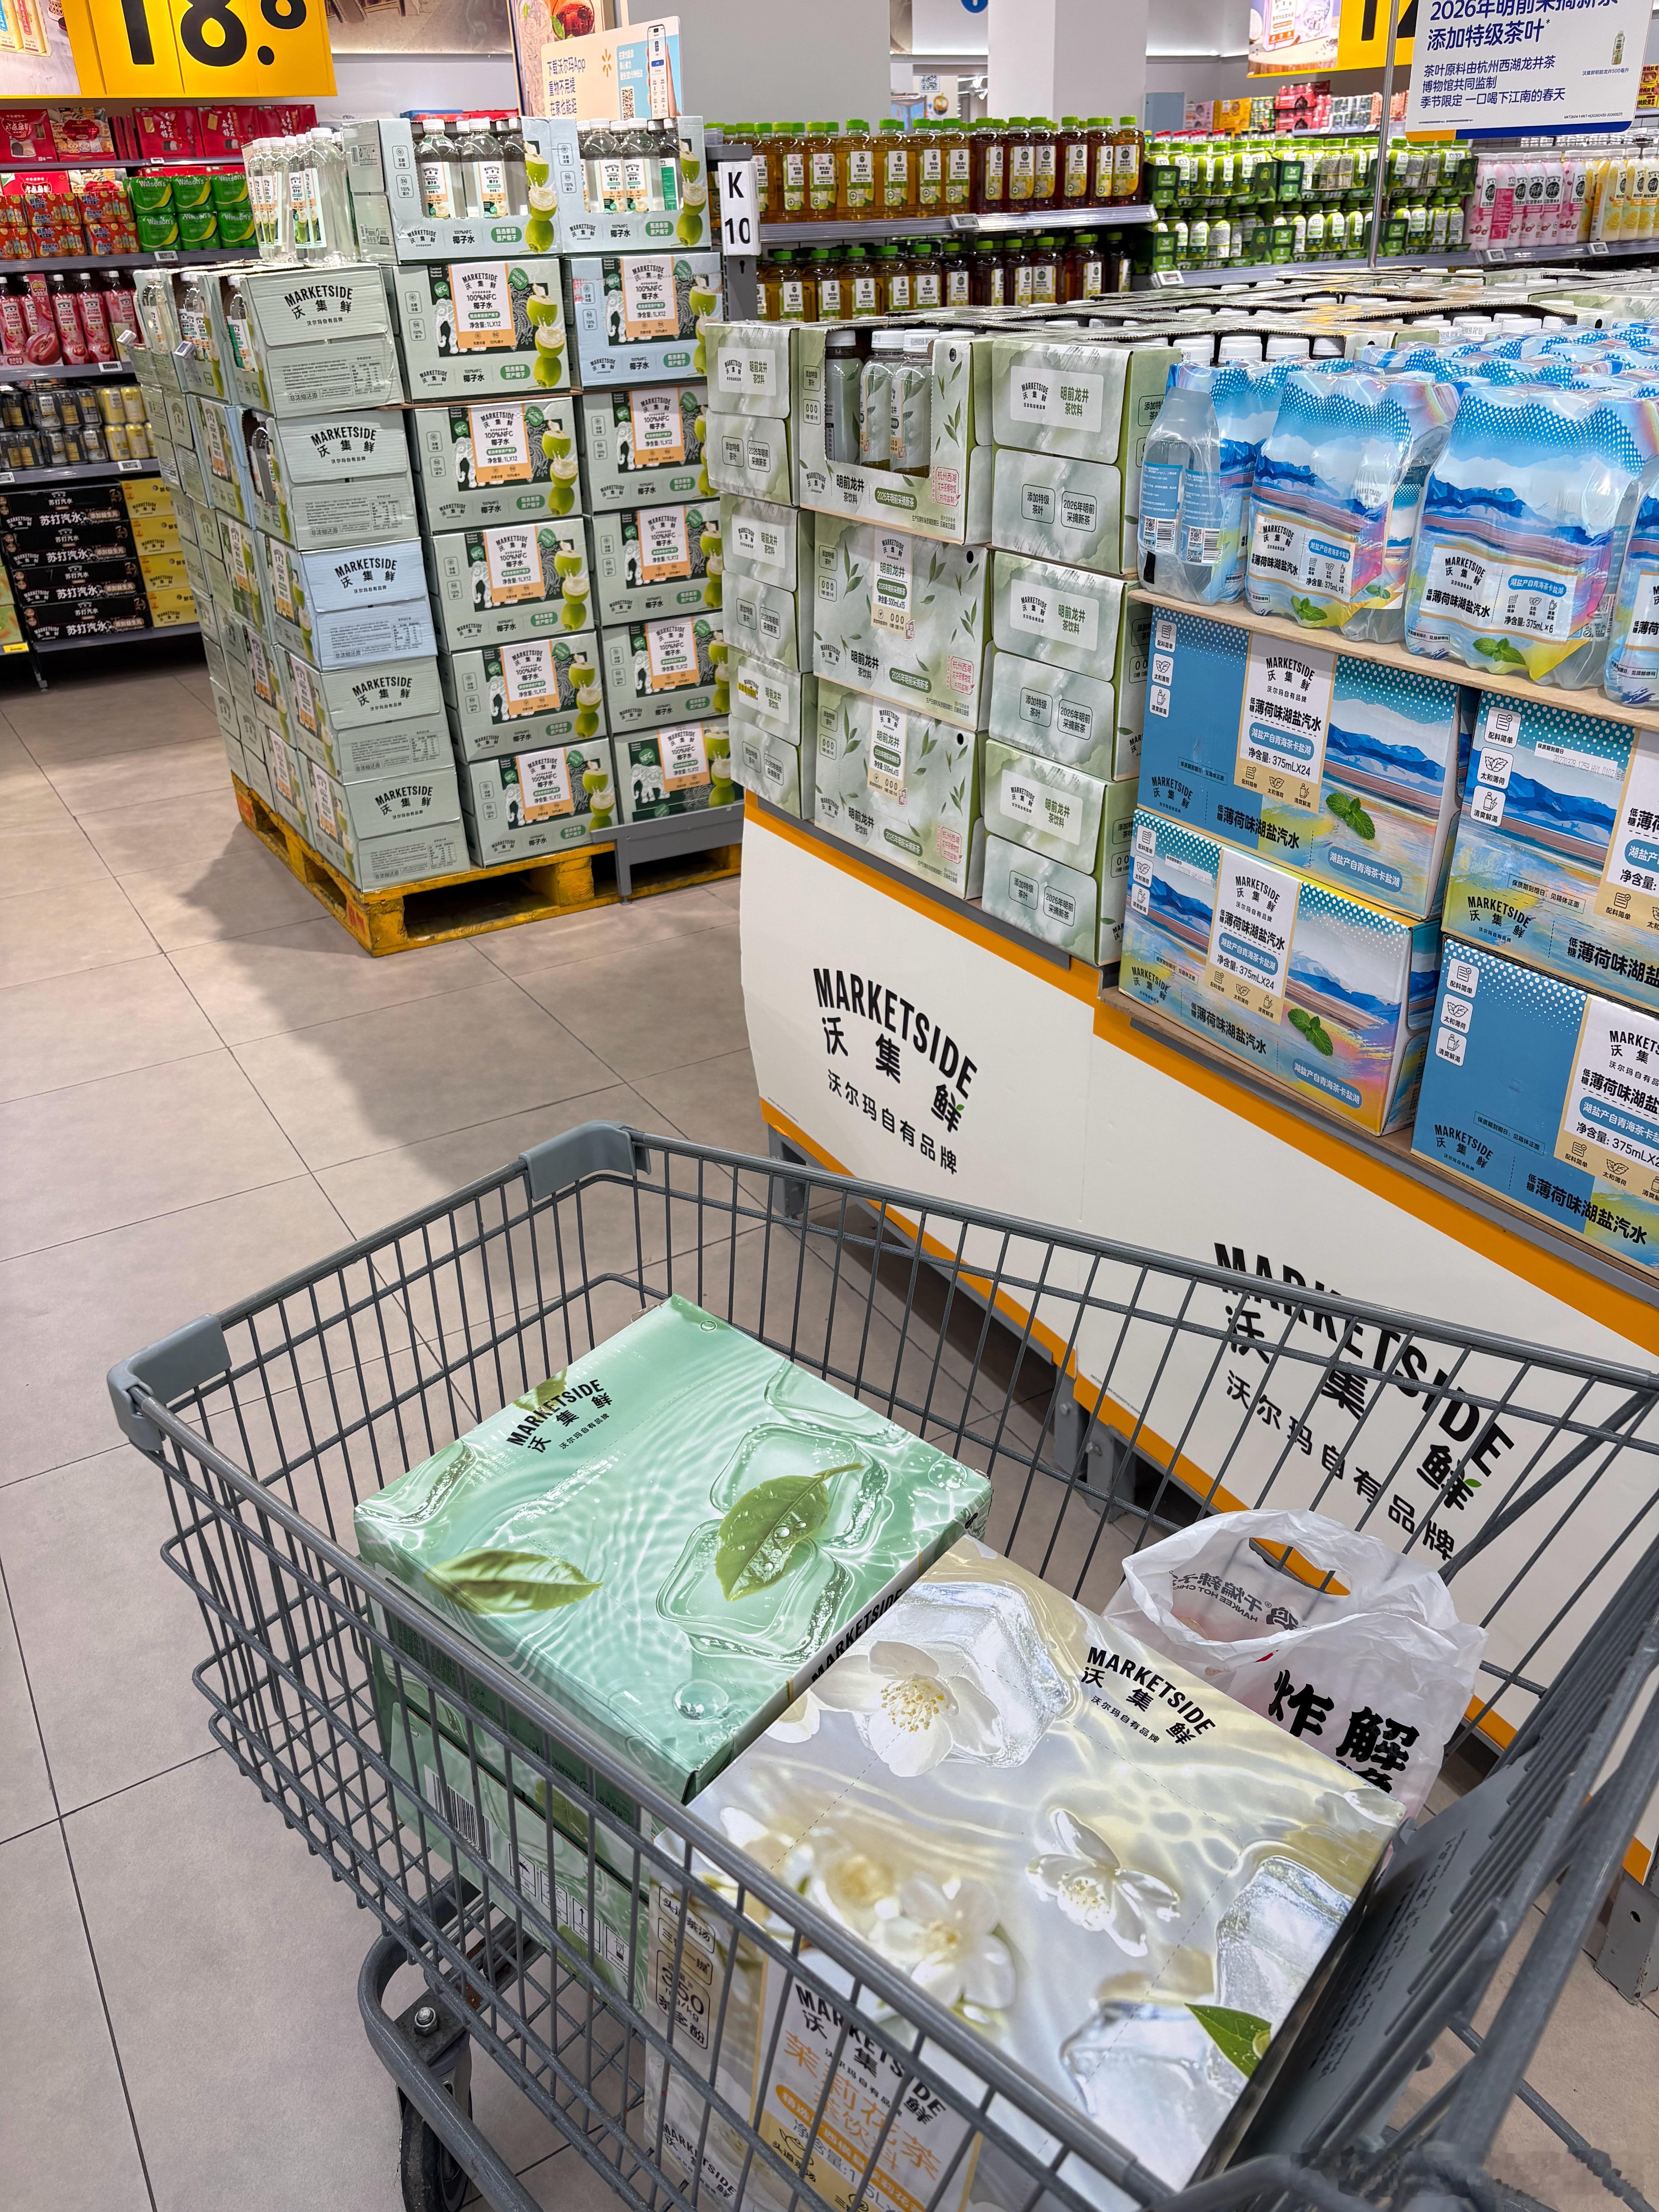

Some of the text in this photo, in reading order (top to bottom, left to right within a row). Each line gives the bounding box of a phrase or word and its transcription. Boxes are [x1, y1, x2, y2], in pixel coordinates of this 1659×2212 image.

[1424, 55, 1556, 77] 茶叶原料由杭州西湖龙井茶
[1422, 76, 1497, 93] 博物馆共同监制
[1420, 88, 1566, 109] 季节限定 一口喝下江南的春天
[728, 171, 744, 199] K
[453, 235, 475, 244] 椰子水
[725, 217, 750, 244] 10
[462, 273, 498, 287] MARKETSIDE
[284, 285, 353, 307] MARKETSIDE
[291, 299, 352, 320] 沃集鲜
[1021, 381, 1049, 395] MARKETSIDE
[1060, 386, 1089, 404] 明前龙井
[480, 411, 515, 421] MARKETSIDE
[1065, 402, 1083, 417] 茶饮料
[311, 426, 377, 446] MARKETSIDE
[318, 440, 374, 458] 沃集鲜
[836, 474, 865, 493] 明前龙井
[1027, 491, 1049, 505] 添加特级
[1063, 499, 1095, 515] 2026年明前
[40, 512, 81, 526] 苏打汽水
[1032, 505, 1043, 516] 茶叶
[1067, 512, 1091, 526] 采摘新茶
[1263, 524, 1294, 541] MARKETSIDE
[46, 549, 89, 563] 苏打汽水
[1254, 553, 1298, 576] 薄荷味湖盐汽水
[335, 558, 397, 578] MARKETSIDE
[879, 562, 905, 578] 明前龙井
[1445, 556, 1486, 578] MARKETSIDE
[1445, 567, 1481, 586] 沃集鲜
[341, 571, 396, 589] 沃集鲜
[1510, 577, 1565, 595] 湖盐产自青海茶卡盐湖
[56, 585, 98, 599] 苏打汽水
[1021, 596, 1048, 610] MARKETSIDE
[1058, 604, 1086, 623] 明前龙井
[1432, 589, 1490, 618] 薄荷味湖盐汽水
[66, 621, 108, 635] 苏打汽水
[1062, 620, 1080, 635] 茶饮料
[850, 650, 879, 670] 明前龙井
[1266, 656, 1315, 682] MARKETSIDE
[352, 676, 413, 697] MARKETSIDE
[1267, 670, 1310, 692] 沃集鲜
[357, 689, 411, 706] 沃集鲜
[1025, 695, 1047, 710] 添加特级
[1267, 685, 1307, 704] 沃尔玛自有品牌
[1030, 708, 1041, 719] 茶叶
[1060, 707, 1091, 725] 2026年明前
[1255, 699, 1321, 732] 薄荷味湖盐汽水
[1063, 718, 1086, 734] 采摘新茶
[1251, 728, 1311, 756] 湖盐产自青海茶卡盐湖
[1487, 731, 1513, 745] 配料简单
[1273, 756, 1311, 777] 375mLX24
[1151, 776, 1193, 799] MARKETSIDE
[1242, 778, 1257, 788] 配料简单
[1480, 771, 1506, 786] 太和薄荷
[375, 785, 433, 806] MARKETSIDE
[1010, 786, 1035, 802] MARKETSIDE
[1153, 787, 1190, 810] 沃集鲜
[380, 797, 431, 816] 沃集鲜
[1045, 798, 1070, 817] 明前龙井
[1474, 809, 1498, 824] 清爽解渴
[1048, 813, 1065, 829] 茶饮料
[1223, 806, 1299, 849] 薄荷味湖盐汽水
[1329, 851, 1400, 888] 湖盐产自青海茶卡盐湖
[1620, 869, 1657, 891] 净含量:
[1014, 878, 1034, 894] 添加特级
[1018, 890, 1028, 901] 茶叶
[1235, 875, 1280, 904] MARKETSIDE
[1045, 893, 1074, 913] 2026年明前
[1236, 887, 1275, 913] 沃集鲜
[1236, 901, 1273, 923] 沃尔玛自有品牌
[1467, 896, 1531, 929] MARKETSIDE
[1605, 905, 1631, 921] 配料简单
[1224, 911, 1286, 951] 薄荷味湖盐汽水
[1469, 909, 1526, 939] 沃集鲜
[1220, 937, 1275, 971] 湖盐产自青海茶卡盐湖
[1577, 940, 1659, 989] 薄荷味湖盐
[1132, 966, 1170, 995] MARKETSIDE
[1239, 965, 1274, 990] 375mLX24
[1450, 981, 1473, 994] 配料简单
[1197, 1008, 1266, 1055] 薄荷味湖盐汽水
[1443, 1015, 1467, 1030] 太和薄荷
[813, 968, 978, 1100] MARKETSIDE
[821, 1017, 962, 1133] 沃集鲜
[1294, 1061, 1360, 1105] 湖盐产自青海茶卡盐湖
[1609, 1060, 1659, 1087] 沃尔玛自有品
[1589, 1072, 1659, 1116] 薄荷味湖盐
[827, 1068, 957, 1175] 沃尔玛自有品牌
[1434, 1124, 1494, 1160] MARKETSIDE
[1576, 1121, 1610, 1146] 净含量:
[1435, 1136, 1489, 1170] 沃集鲜
[1565, 1152, 1627, 1187] 配料简单 太和薄荷
[1535, 1177, 1648, 1246] 薄荷味湖盐汽水
[506, 1379, 604, 1446] MARKETSIDE
[527, 1392, 613, 1453] 沃集鲜
[558, 1413, 610, 1449] 沃尔玛自有品牌
[1226, 1369, 1455, 1561] 沃尔玛自有品牌
[1086, 1646, 1217, 1736] MARKETSIDE
[1081, 1666, 1197, 1745] 沃集鲜
[1091, 1695, 1161, 1744] 沃尔玛自有品牌
